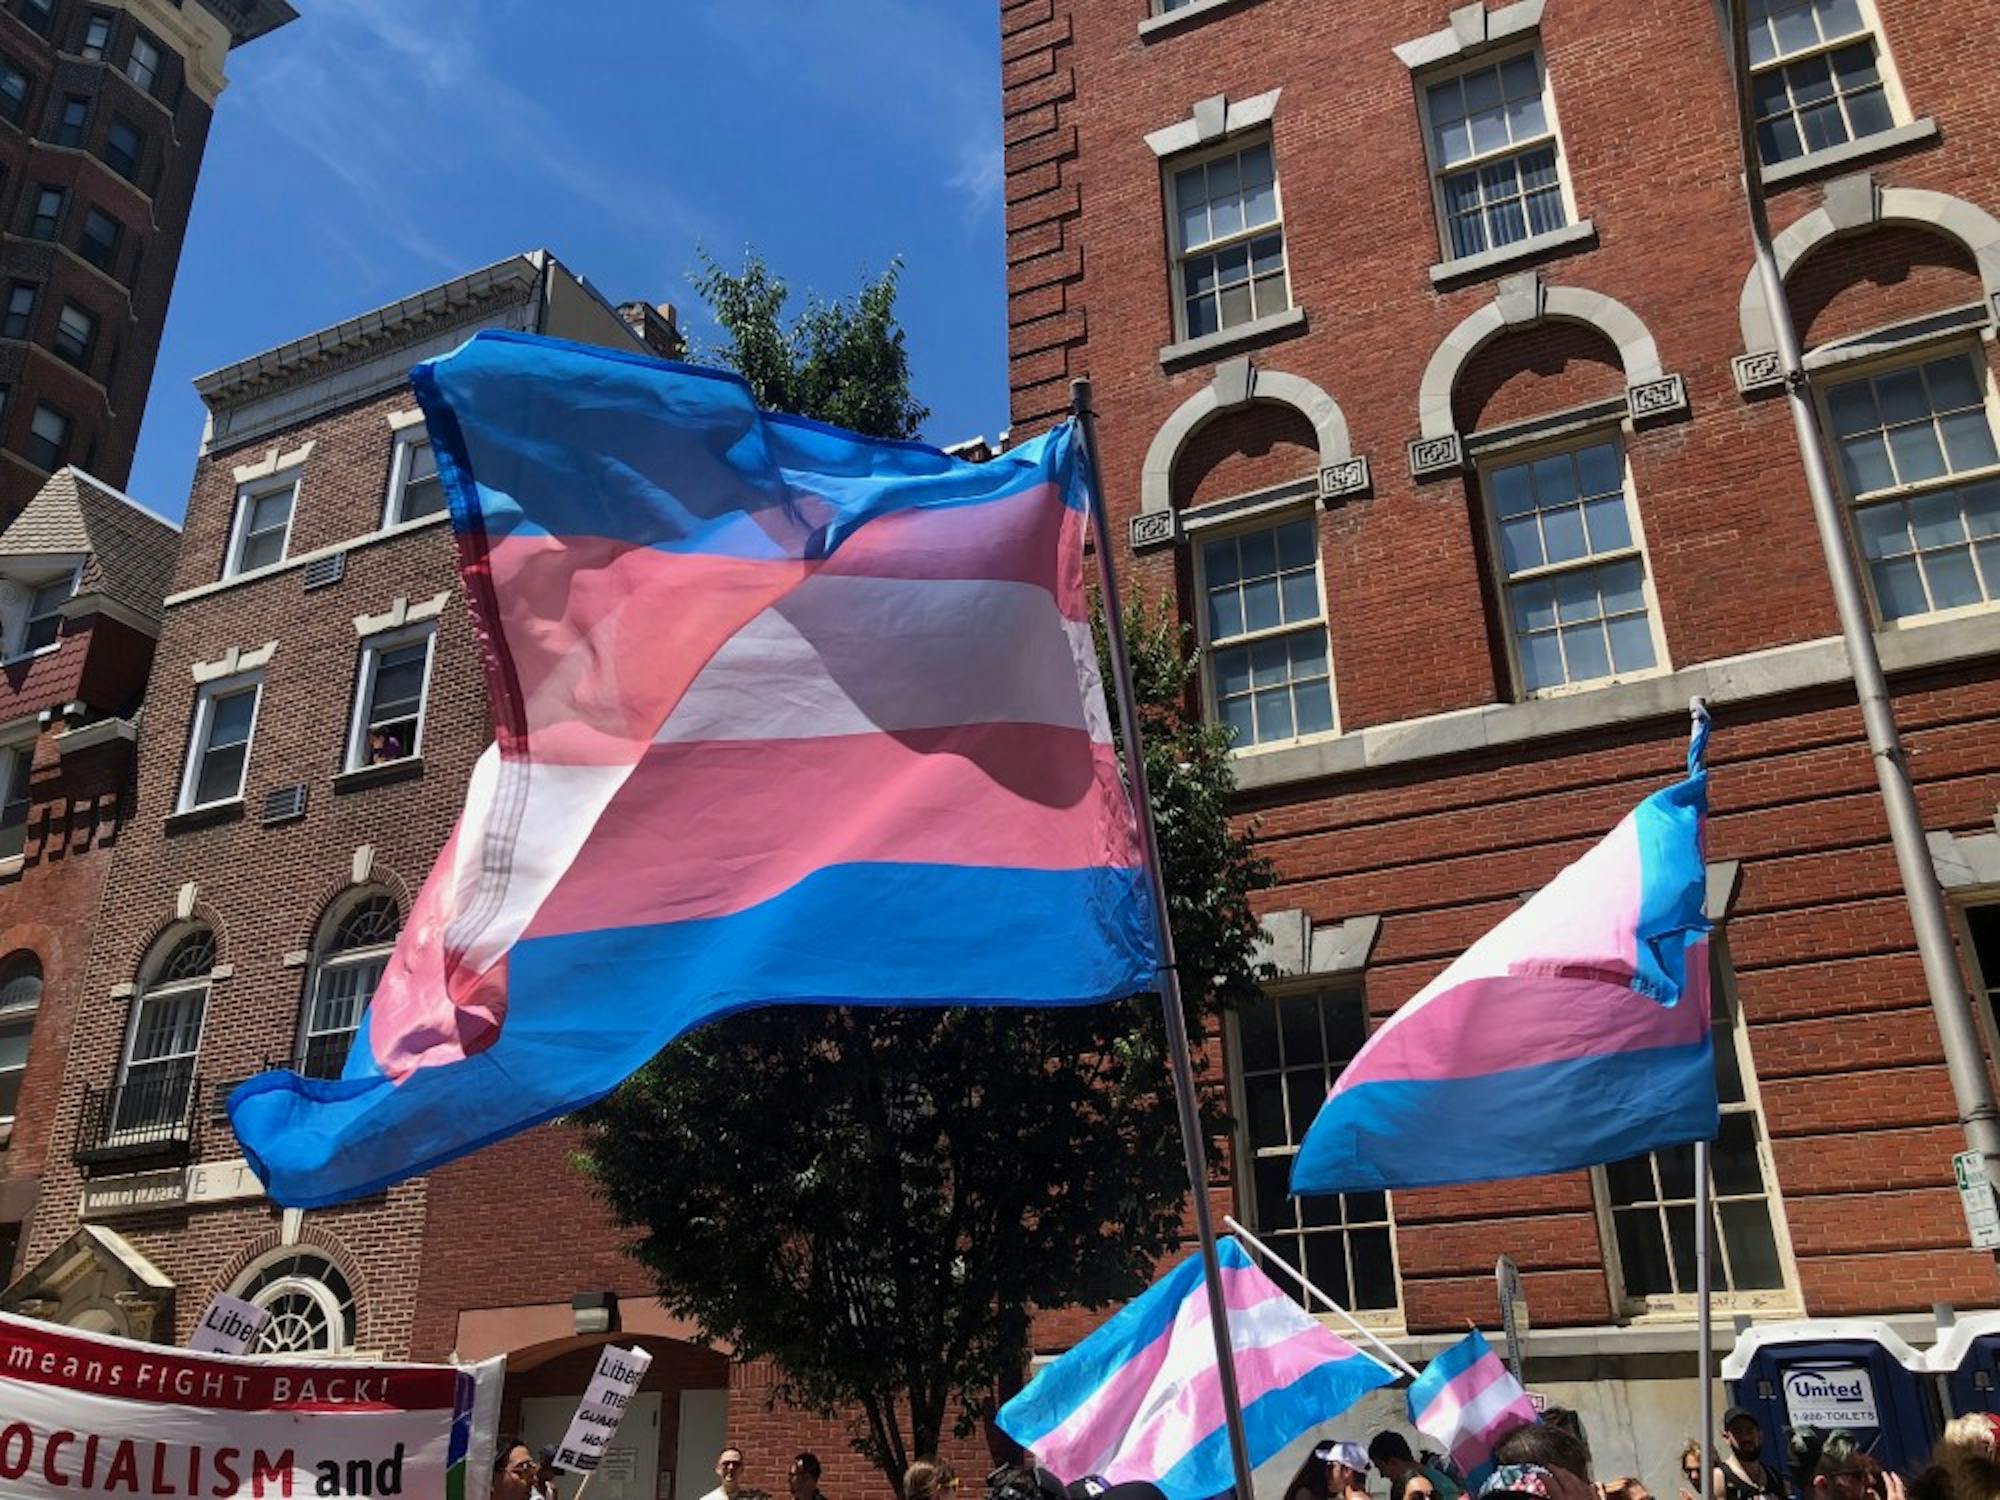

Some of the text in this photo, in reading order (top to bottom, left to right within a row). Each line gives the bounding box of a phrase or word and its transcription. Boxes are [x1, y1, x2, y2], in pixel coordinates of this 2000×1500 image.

[7, 1345, 389, 1403] means FIGHT BACK!
[1795, 1380, 1862, 1397] United
[315, 1441, 404, 1497] and
